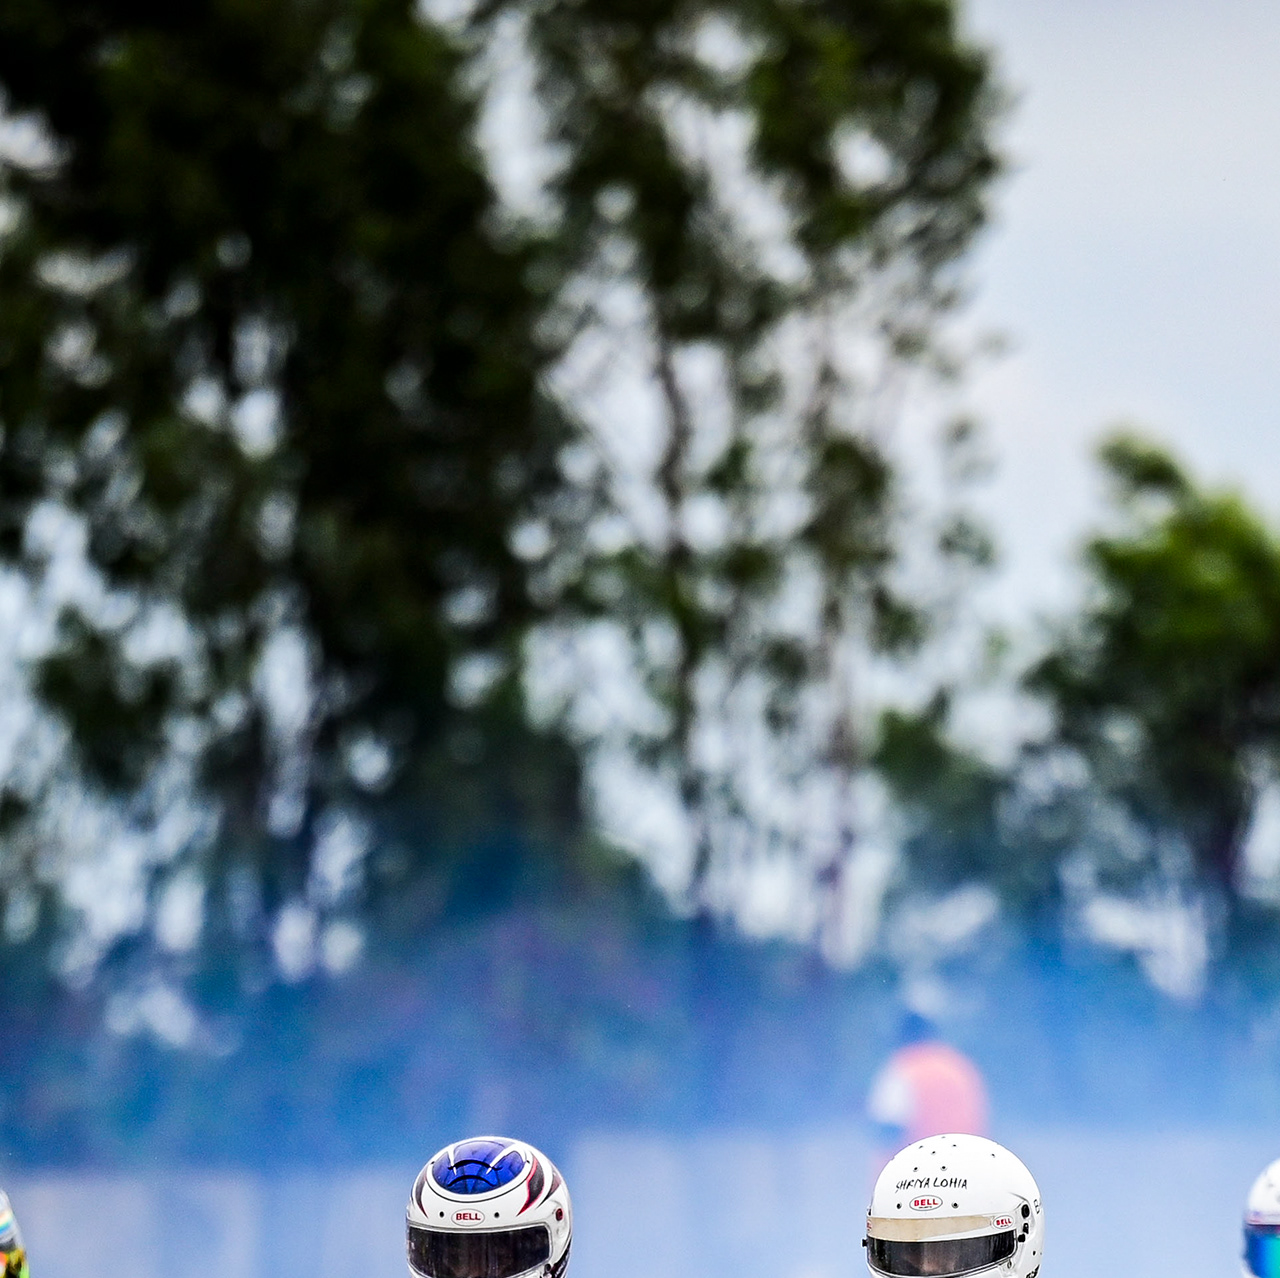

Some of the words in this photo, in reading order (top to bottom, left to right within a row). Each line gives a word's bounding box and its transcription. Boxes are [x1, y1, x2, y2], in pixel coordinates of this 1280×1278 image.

[913, 1198, 939, 1207] BELL
[455, 1212, 481, 1221] BELL
[995, 1217, 1012, 1226] BELL
